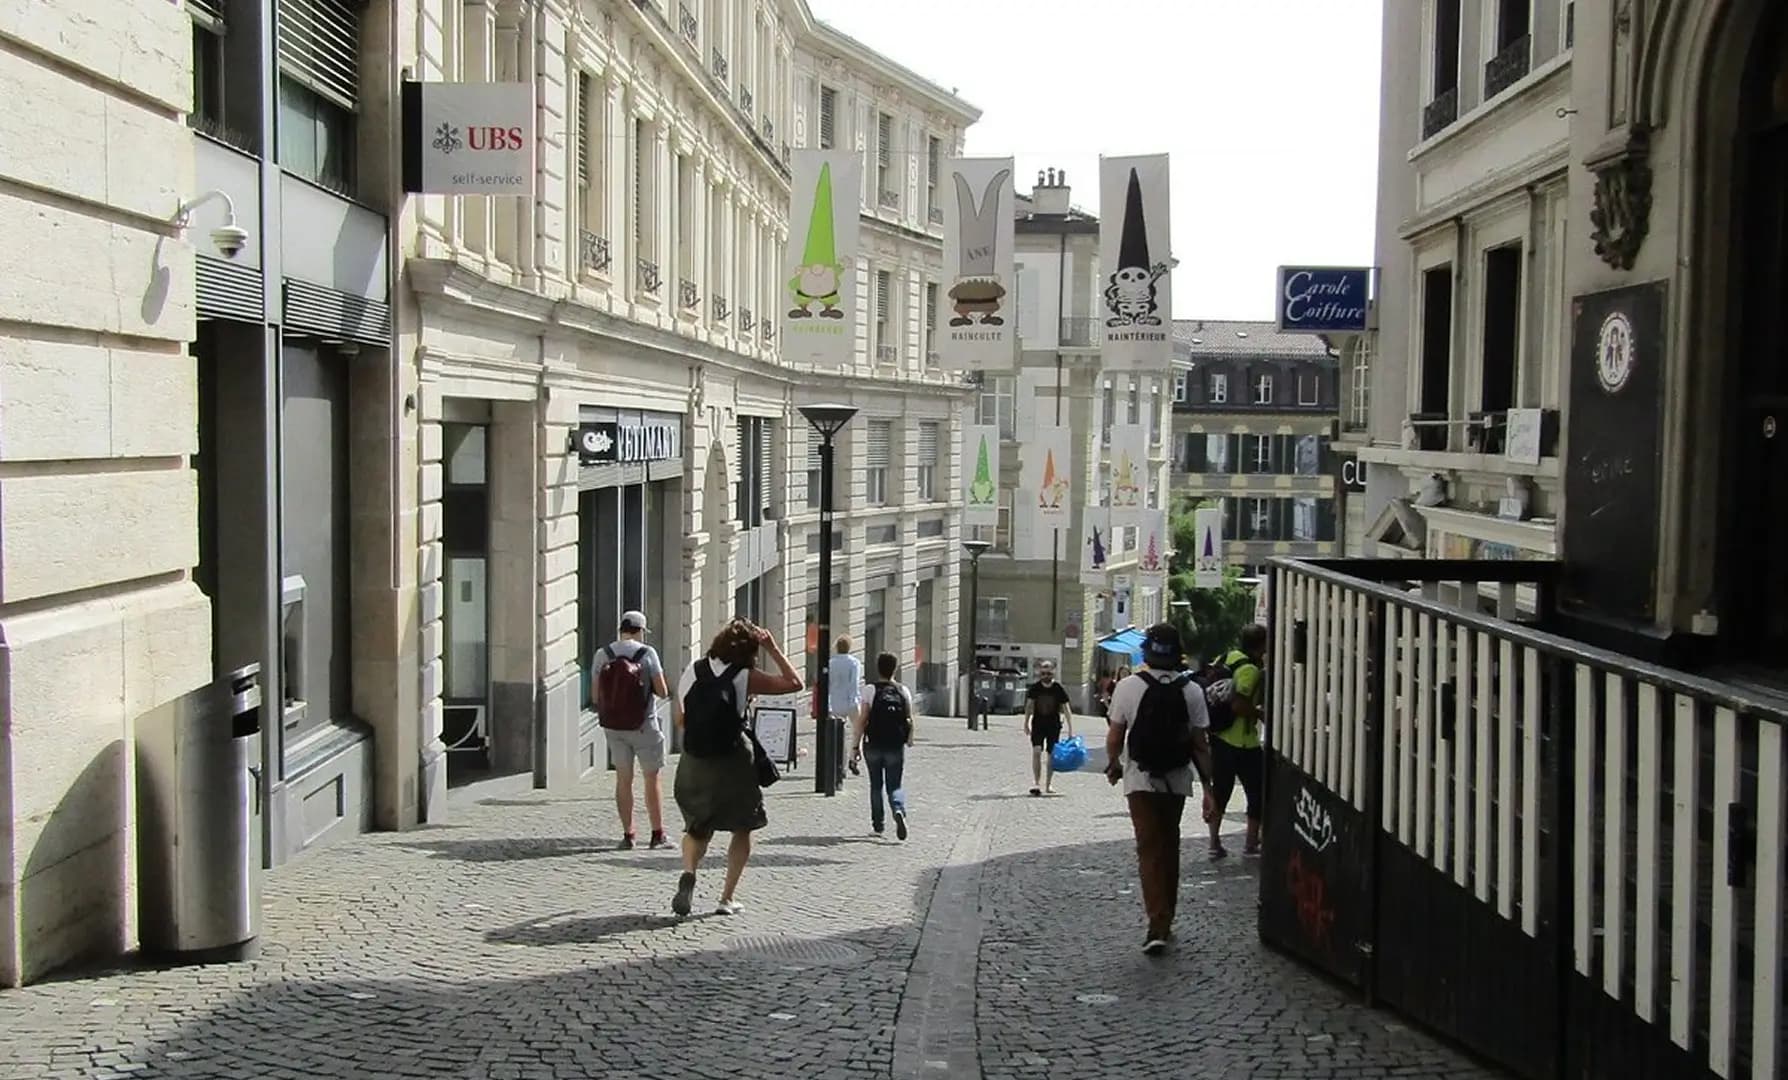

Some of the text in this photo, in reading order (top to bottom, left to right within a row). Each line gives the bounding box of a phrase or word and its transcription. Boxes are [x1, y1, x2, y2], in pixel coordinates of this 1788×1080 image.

[467, 126, 523, 151] UBS
[452, 172, 522, 185] self-service
[1285, 271, 1350, 301] Carole
[1286, 294, 1364, 321] Coiffure
